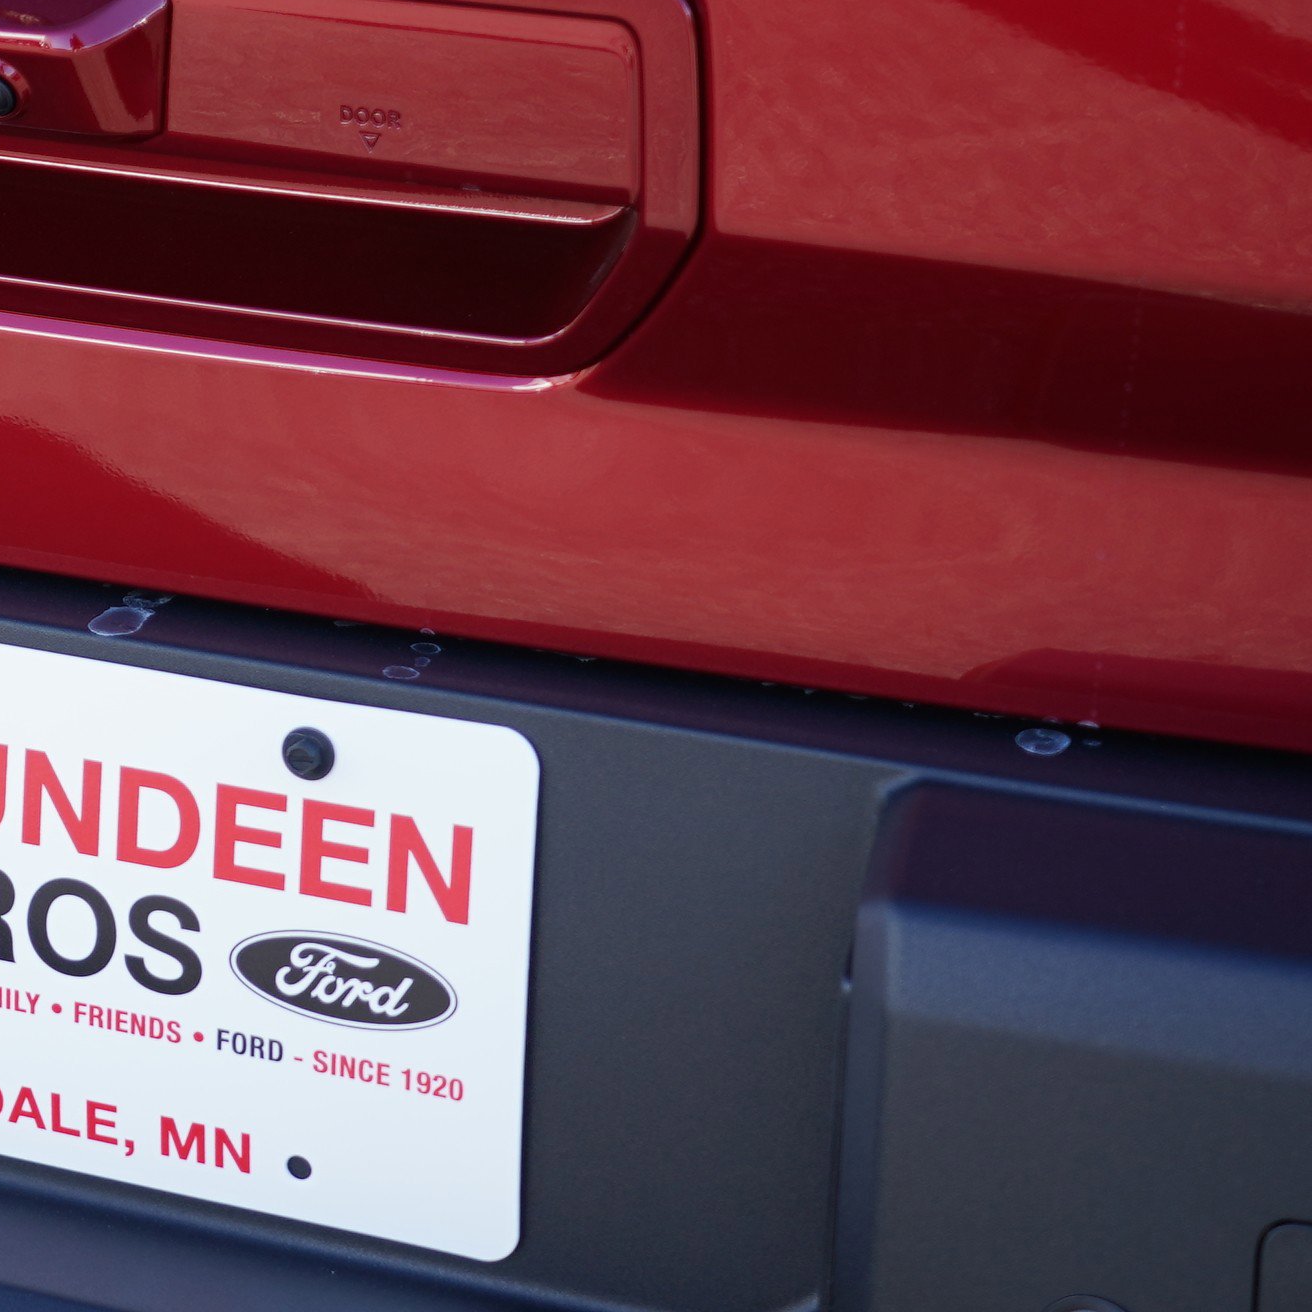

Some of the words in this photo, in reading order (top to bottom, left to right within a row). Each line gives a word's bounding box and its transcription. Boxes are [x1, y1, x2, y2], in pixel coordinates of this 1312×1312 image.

[339, 104, 401, 130] DOOR
[275, 942, 414, 1017] Ford
[74, 1001, 182, 1044] FRIENDS
[216, 1028, 284, 1062] FORD
[312, 1049, 391, 1087] SINCE
[401, 1068, 465, 1102] 1920
[160, 1114, 252, 1174] MN
